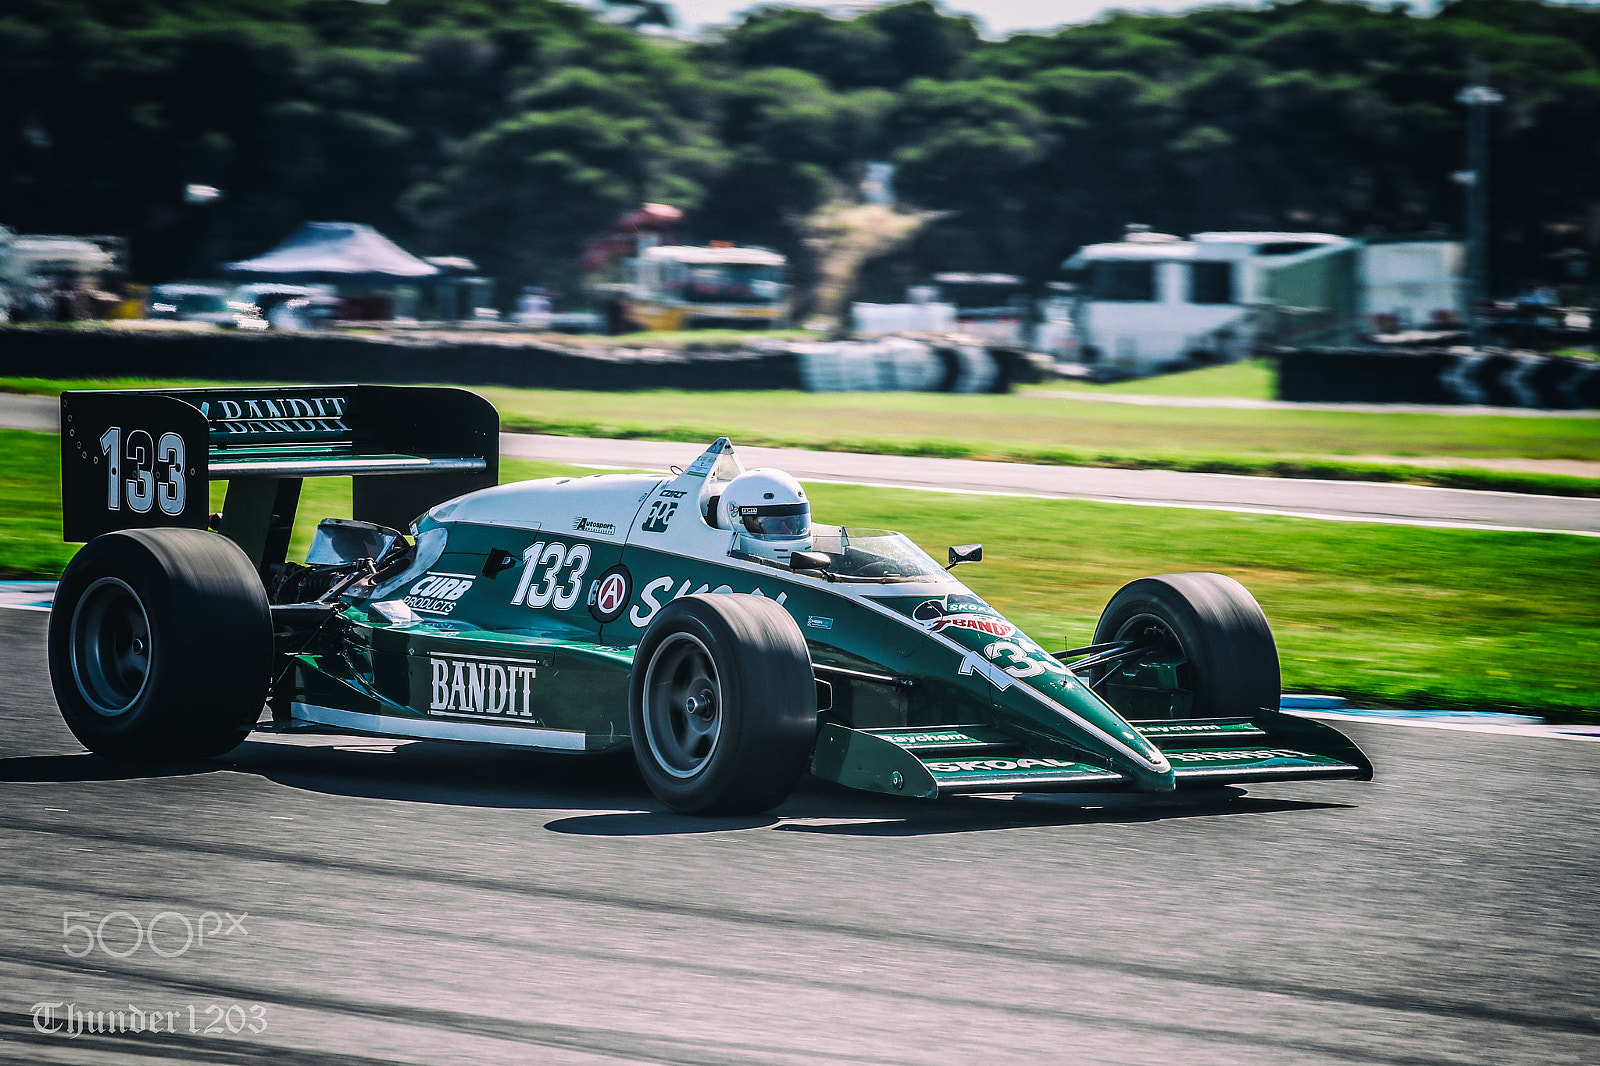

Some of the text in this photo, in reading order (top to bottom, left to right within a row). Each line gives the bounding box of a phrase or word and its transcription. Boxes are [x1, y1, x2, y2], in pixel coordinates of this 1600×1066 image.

[99, 426, 186, 516] 133
[576, 517, 614, 530] Autosport
[409, 575, 473, 601] CURB
[510, 541, 592, 611] 133
[403, 595, 457, 612] PRODUCTS
[430, 658, 536, 717] BANDIT
[927, 758, 1076, 772] SKOAL
